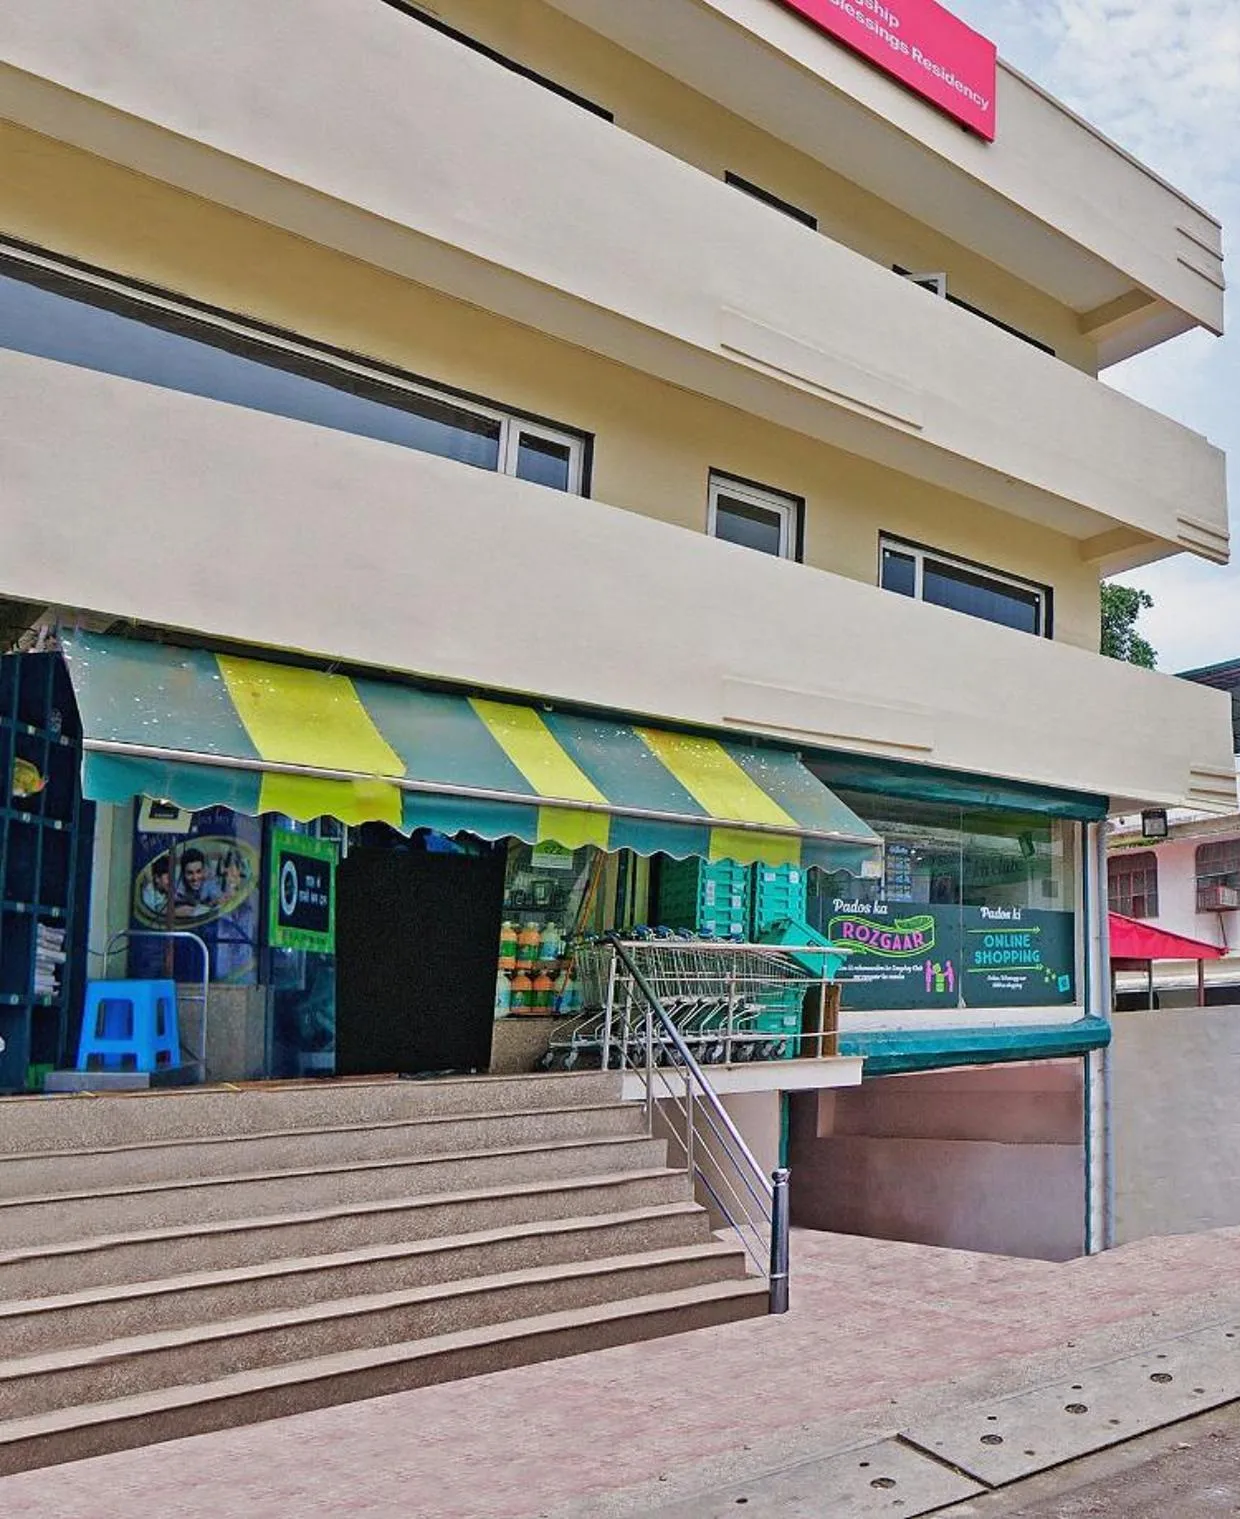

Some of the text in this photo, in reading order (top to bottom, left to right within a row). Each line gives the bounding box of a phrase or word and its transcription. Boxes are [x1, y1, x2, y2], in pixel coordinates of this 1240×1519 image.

[911, 47, 990, 111] Residency
[833, 898, 888, 914] Pados ka
[980, 906, 1011, 920] Pados
[842, 921, 924, 950] ROZGAAR
[983, 934, 1031, 948] ONLINE
[974, 950, 1041, 964] SHOPPING
